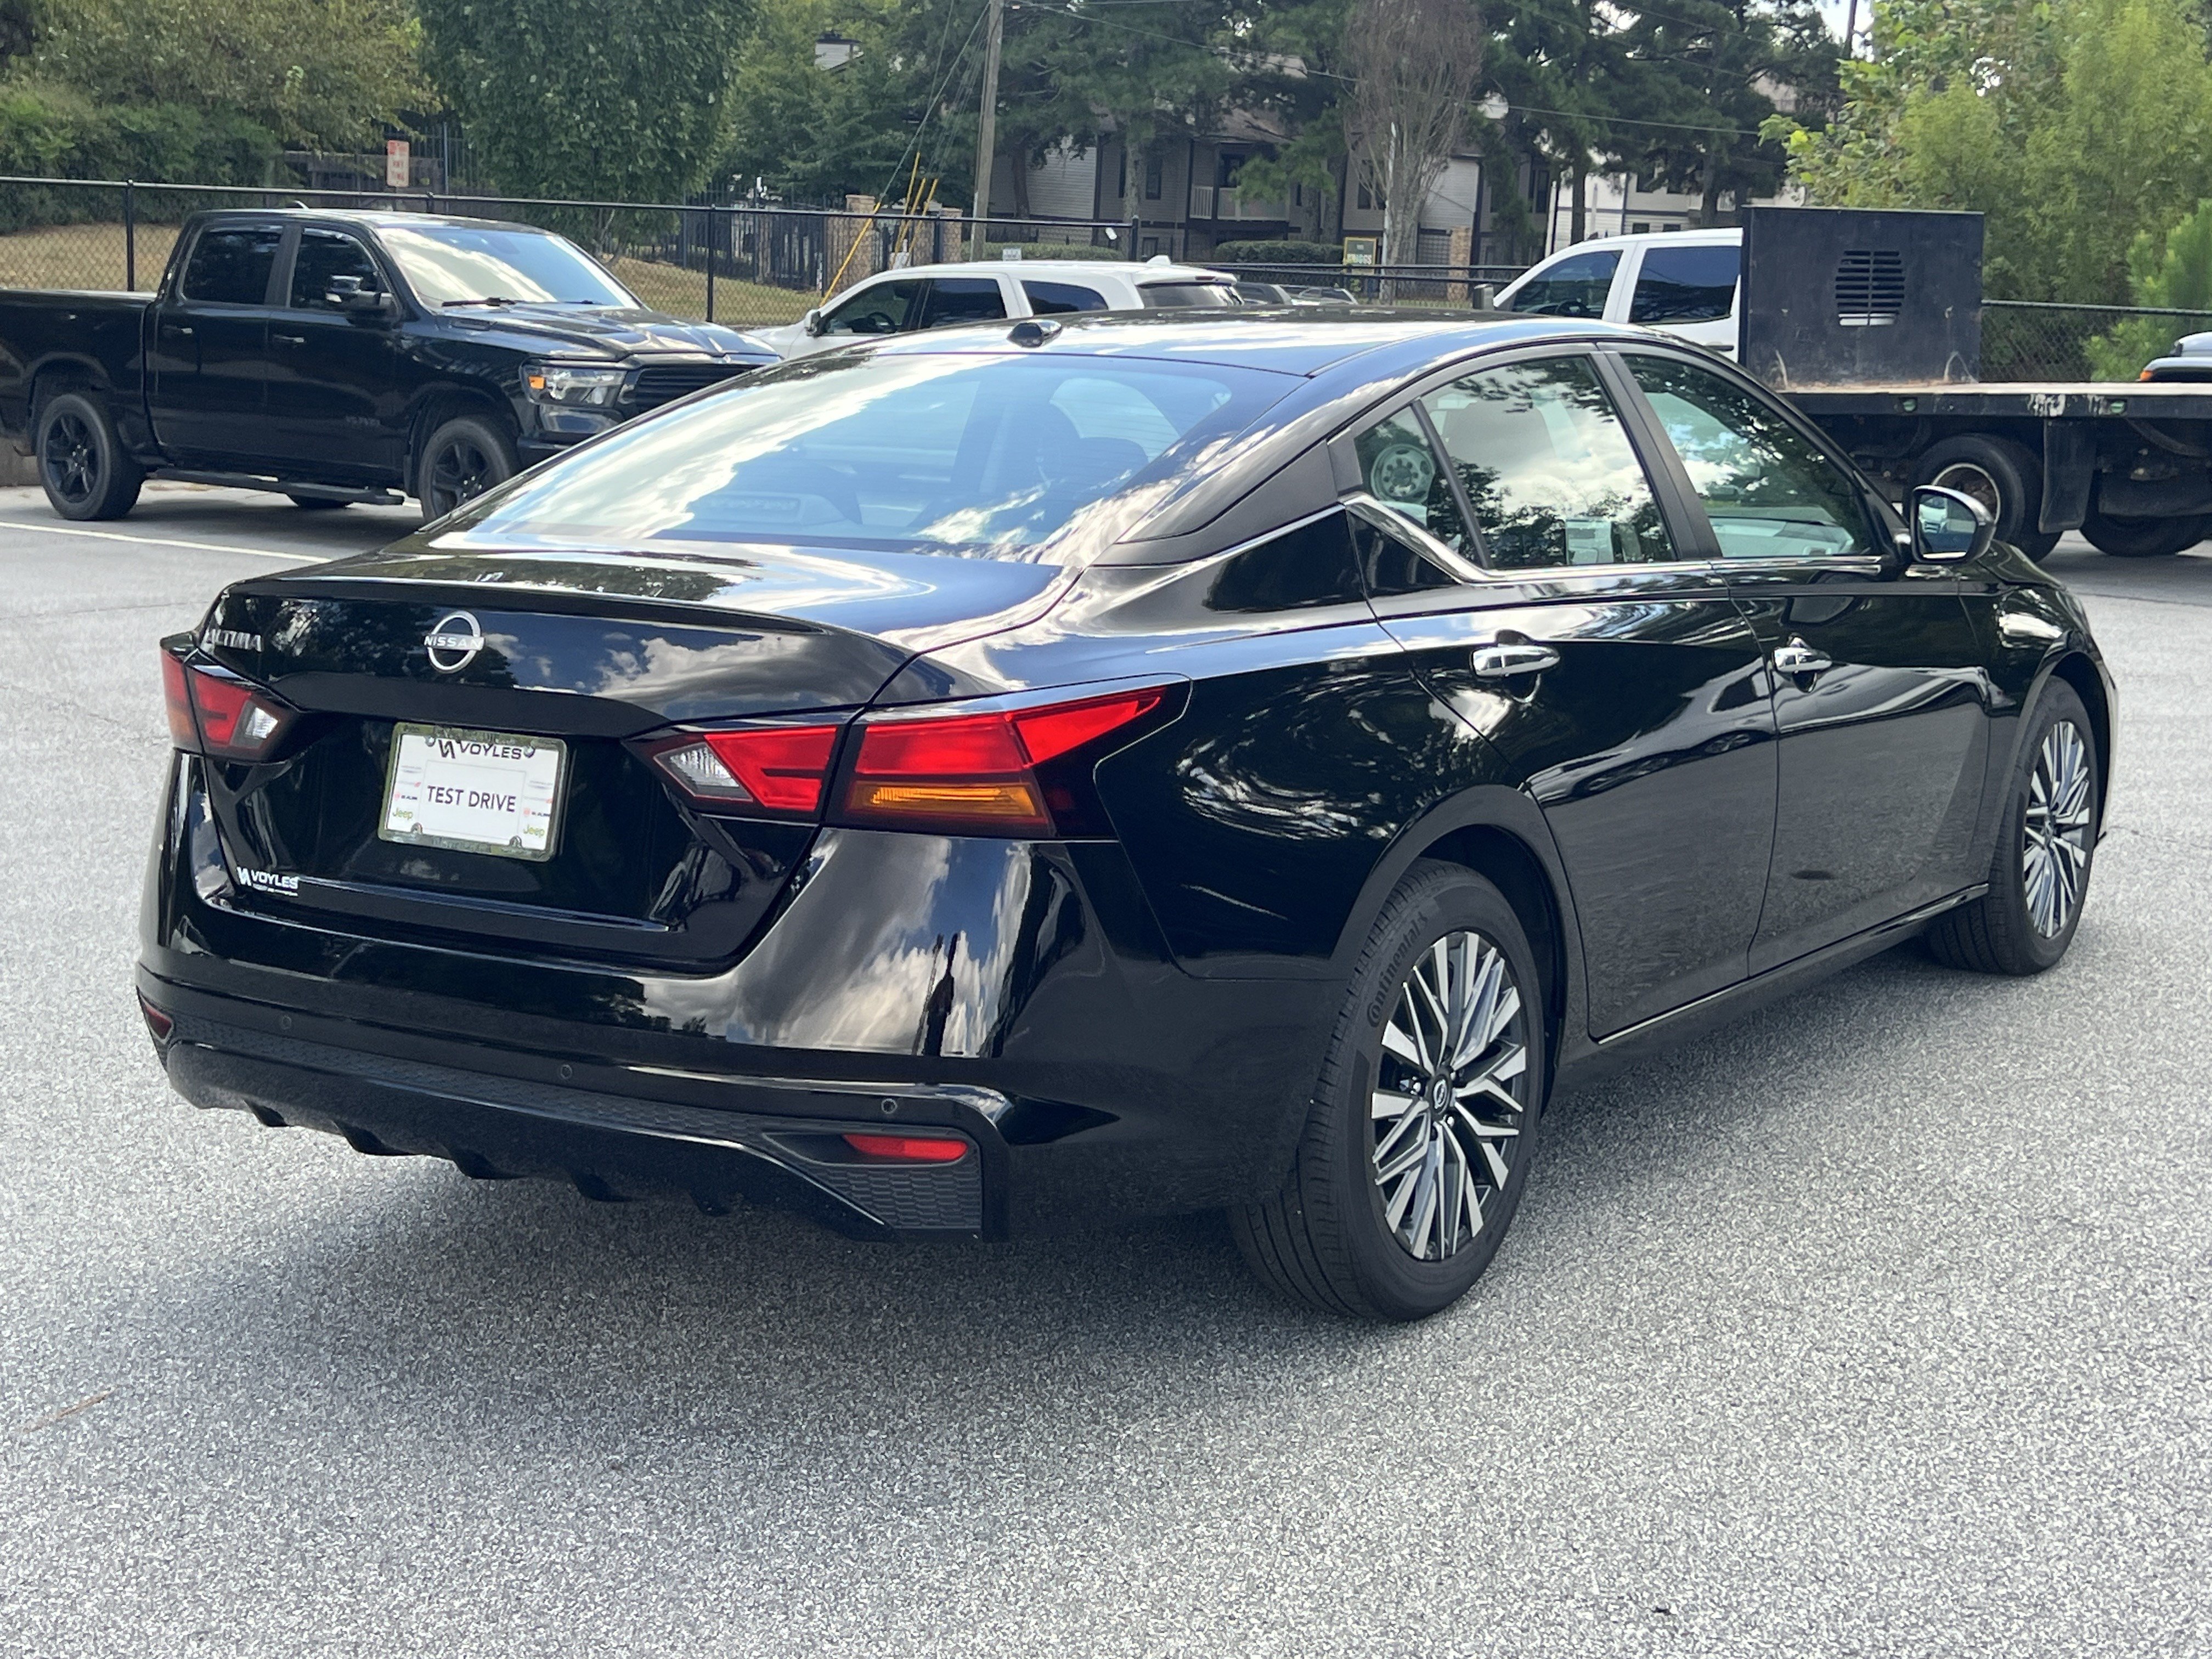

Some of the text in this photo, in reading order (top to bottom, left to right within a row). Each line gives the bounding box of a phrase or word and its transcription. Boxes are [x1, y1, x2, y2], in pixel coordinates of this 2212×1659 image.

[424, 636, 483, 650] NISSAN
[459, 742, 523, 760] VOYLES
[427, 785, 464, 806] TEST
[468, 791, 516, 812] DRIVE
[392, 807, 413, 820] Jeep
[523, 824, 545, 838] Jeep
[251, 869, 299, 889] VOYLES
[1367, 919, 1421, 1028] Continental
